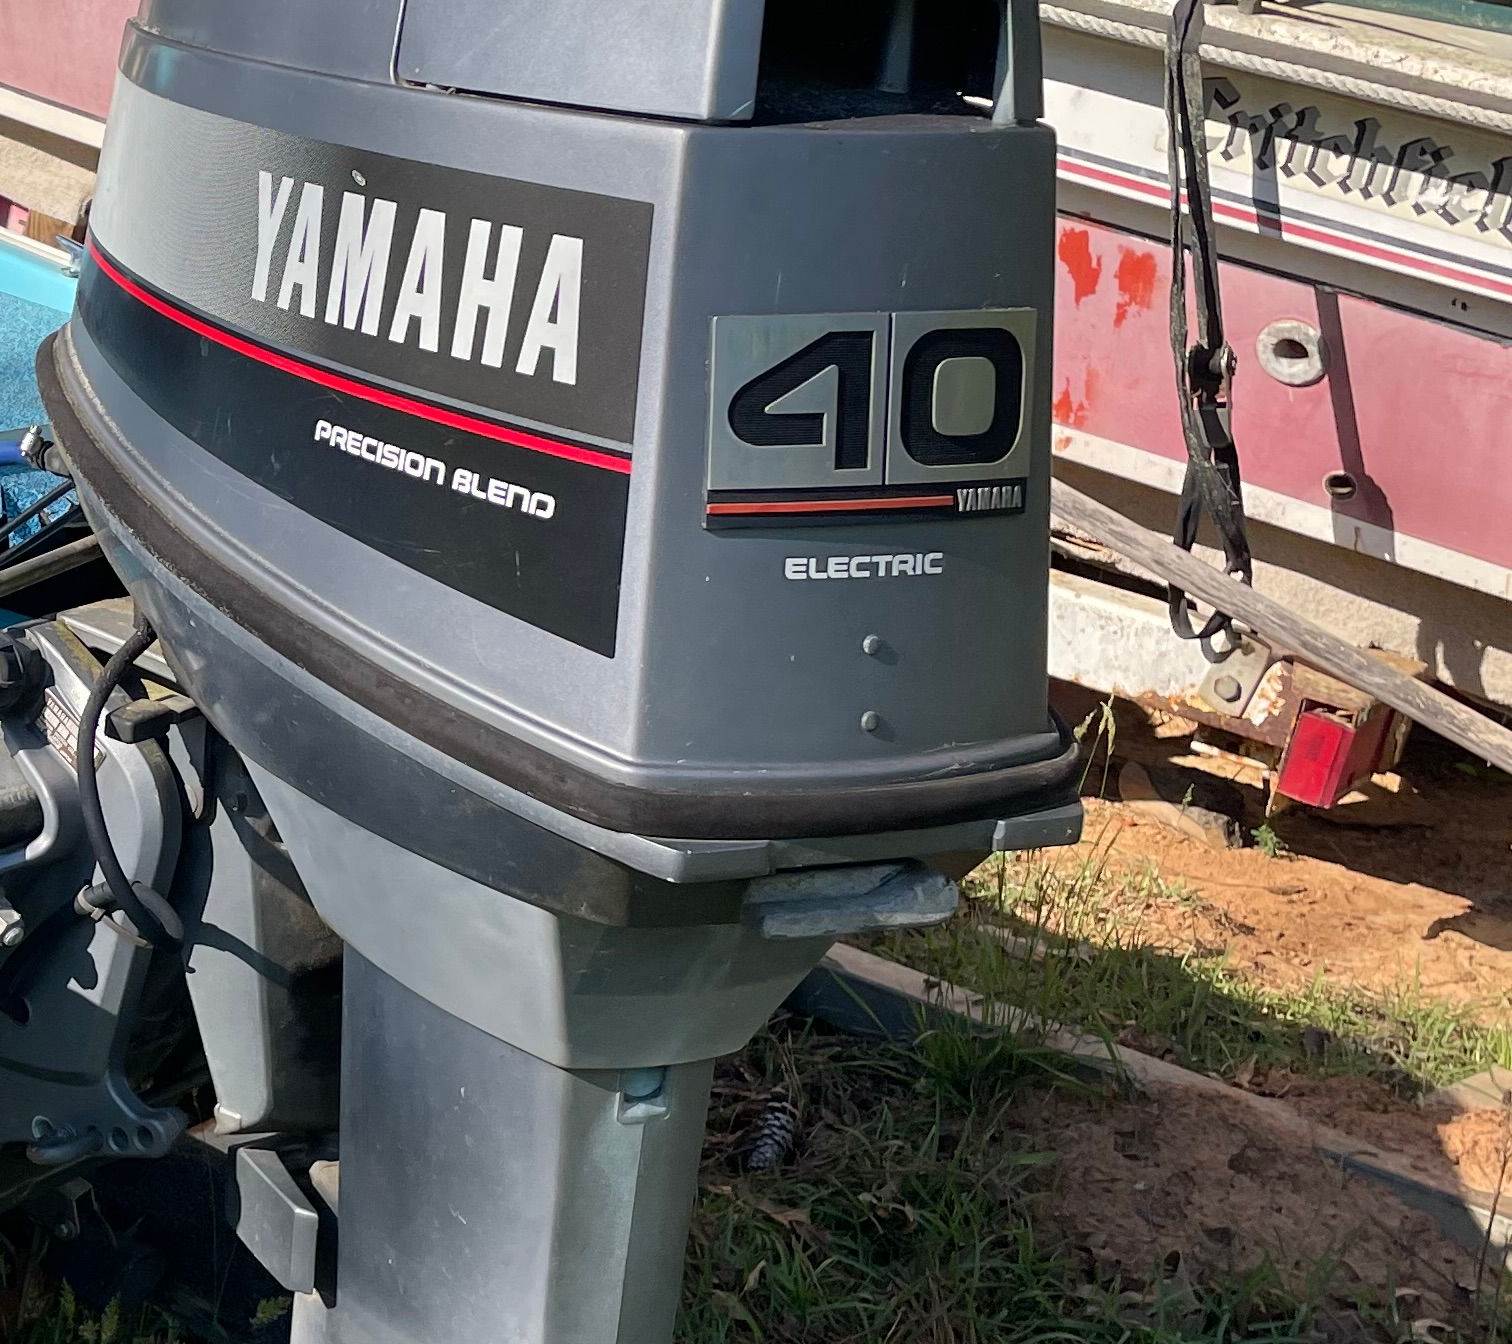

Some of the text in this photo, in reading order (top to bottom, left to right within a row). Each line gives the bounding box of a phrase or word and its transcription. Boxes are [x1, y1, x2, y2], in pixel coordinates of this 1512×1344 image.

[251, 169, 585, 386] YAMAHA
[727, 327, 1025, 471] 40
[313, 419, 556, 519] PRECISION BLEND
[956, 485, 1023, 513] YAMAHA
[784, 552, 944, 580] ELECTRIC
